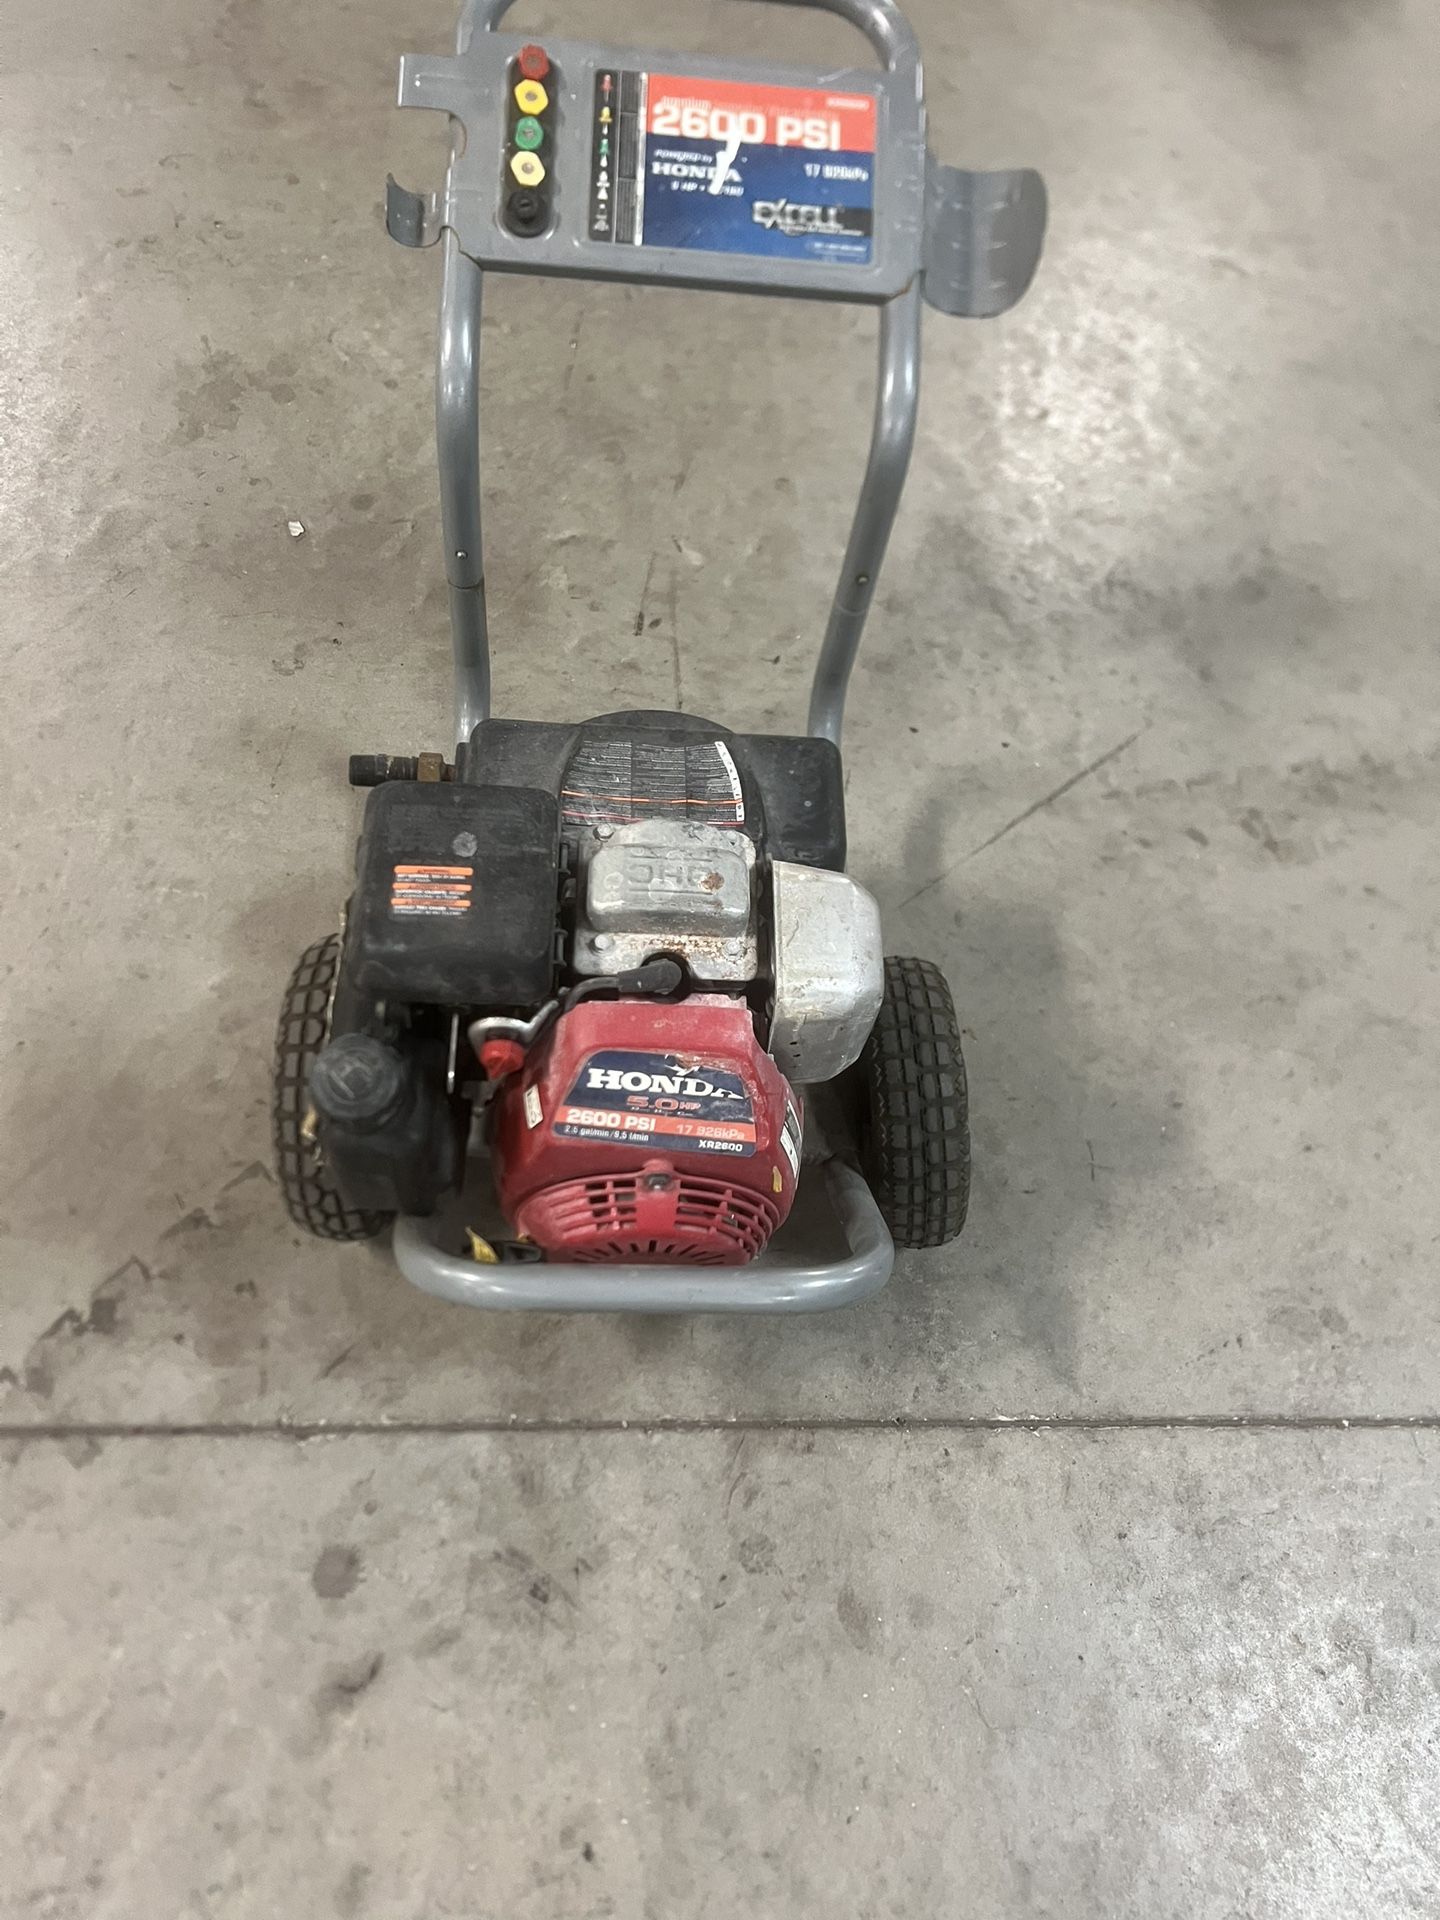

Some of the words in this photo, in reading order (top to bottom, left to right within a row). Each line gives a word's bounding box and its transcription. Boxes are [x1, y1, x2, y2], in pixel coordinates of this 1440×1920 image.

[652, 101, 767, 144] 2600
[775, 116, 842, 151] PSI
[586, 1068, 745, 1100] HONDA
[566, 1108, 621, 1128] 2600
[624, 1115, 656, 1132] PSI
[676, 1124, 693, 1136] 17
[698, 1139, 743, 1152] XR2600
